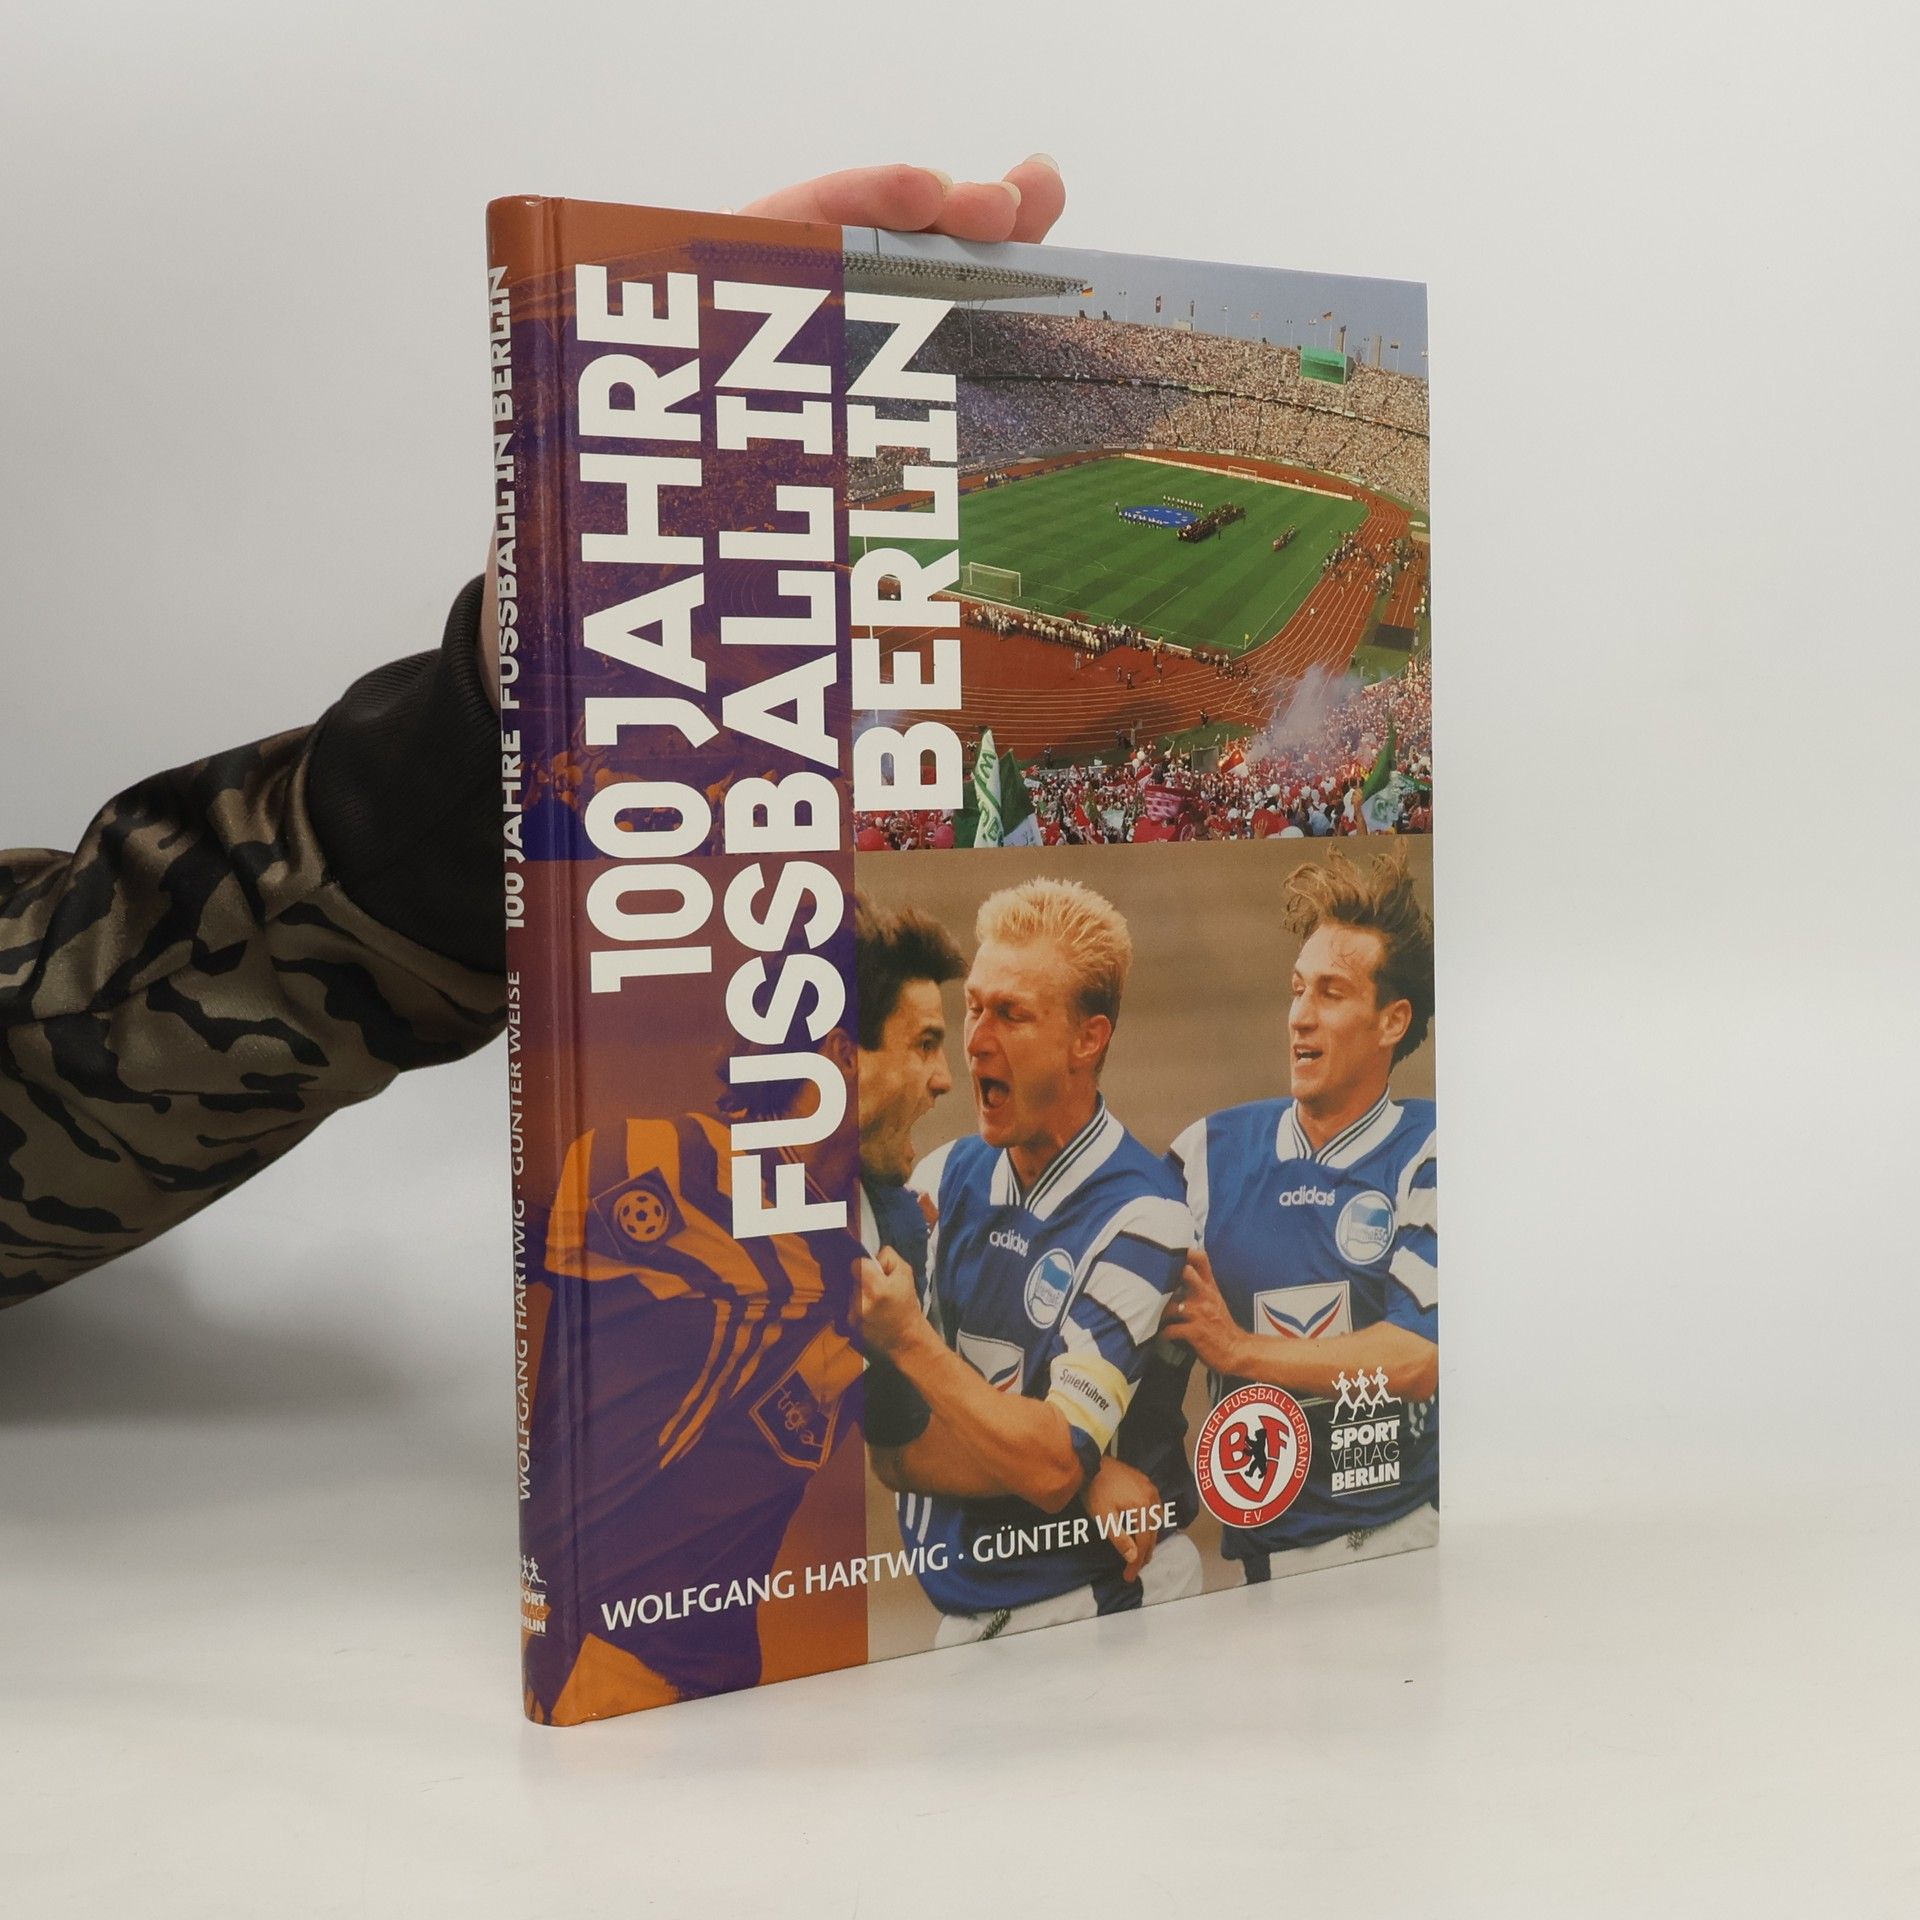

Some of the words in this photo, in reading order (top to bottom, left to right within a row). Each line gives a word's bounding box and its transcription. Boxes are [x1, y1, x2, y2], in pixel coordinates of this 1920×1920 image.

[488, 266, 513, 422] BERLIN
[713, 280, 833, 455] IN
[494, 433, 514, 483] IN
[575, 263, 719, 749] JAHRE
[496, 489, 519, 709] FUSSBALL
[844, 291, 963, 811] BERLIN
[501, 729, 526, 864] JAHRE
[505, 872, 525, 931] 100
[584, 781, 713, 994] 100
[719, 485, 847, 1239] FUSSBALL
[507, 971, 521, 1054] WEISE
[1279, 1185, 1336, 1207] adidas
[512, 1200, 527, 1330] HARTWIG
[514, 1339, 531, 1500] WOLFGANG
[1060, 1368, 1110, 1412] Spielführer
[1199, 1412, 1225, 1491] BERLINER
[1331, 1419, 1400, 1451] SPORT
[1330, 1441, 1400, 1471] VERLAG
[1332, 1461, 1400, 1492] BERLIN
[600, 1570, 795, 1631] WOLFGANG
[804, 1543, 949, 1596] HARTWIG
[972, 1516, 1089, 1563] GÜNTER
[1095, 1501, 1177, 1538] WEISE
